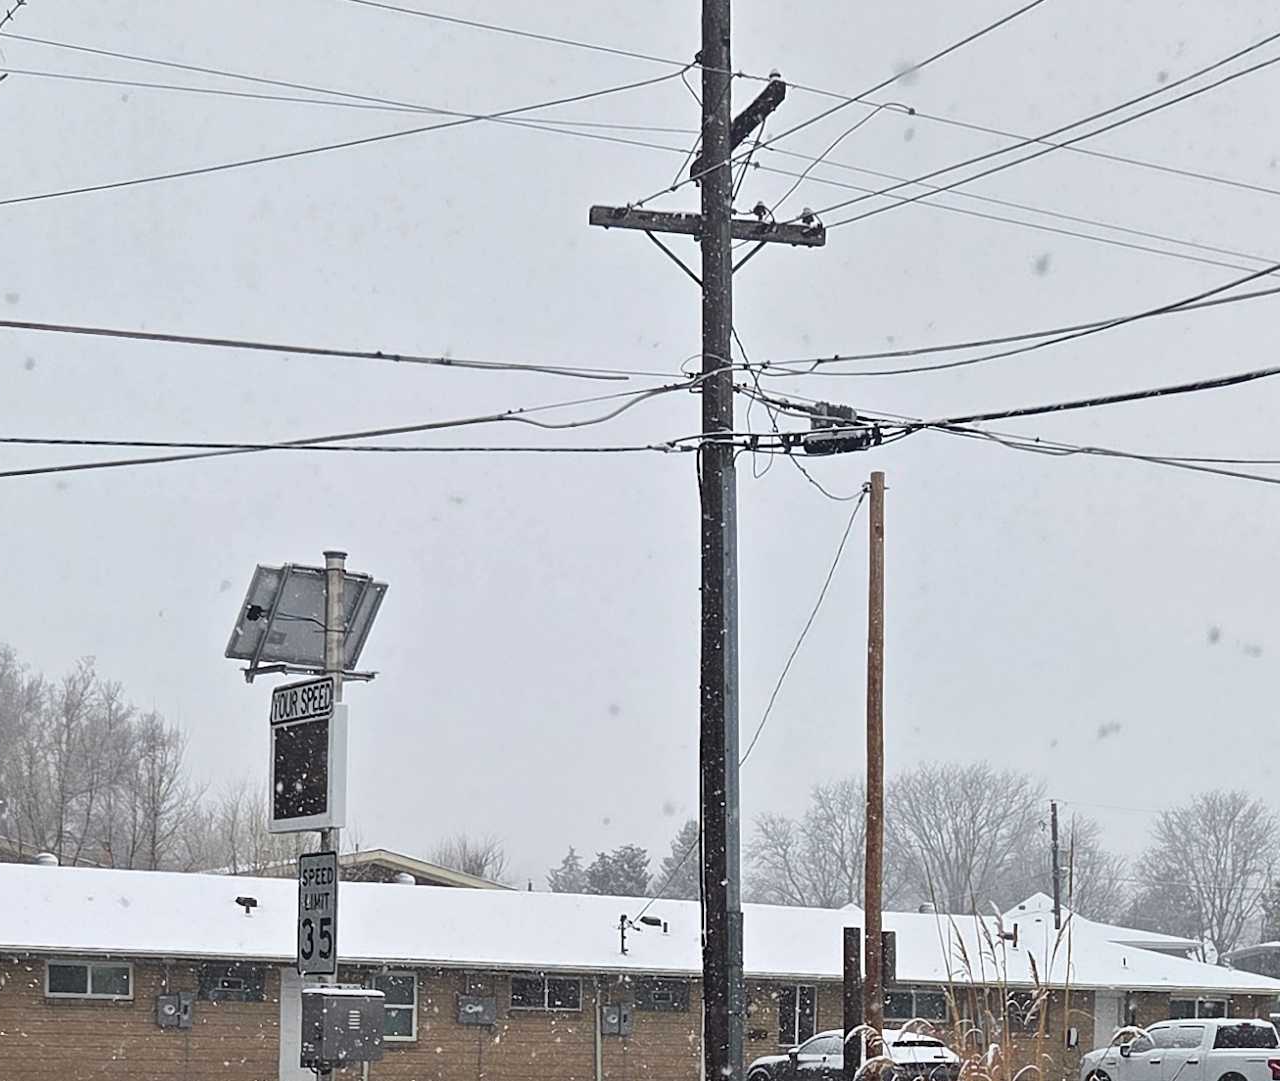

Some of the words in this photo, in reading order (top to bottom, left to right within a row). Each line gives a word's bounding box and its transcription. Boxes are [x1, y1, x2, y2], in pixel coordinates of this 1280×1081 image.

[273, 690, 298, 720] YOUR
[301, 683, 333, 714] SPEED
[302, 867, 333, 886] SPEED
[304, 892, 330, 910] LIMIT
[301, 917, 332, 960] 35
